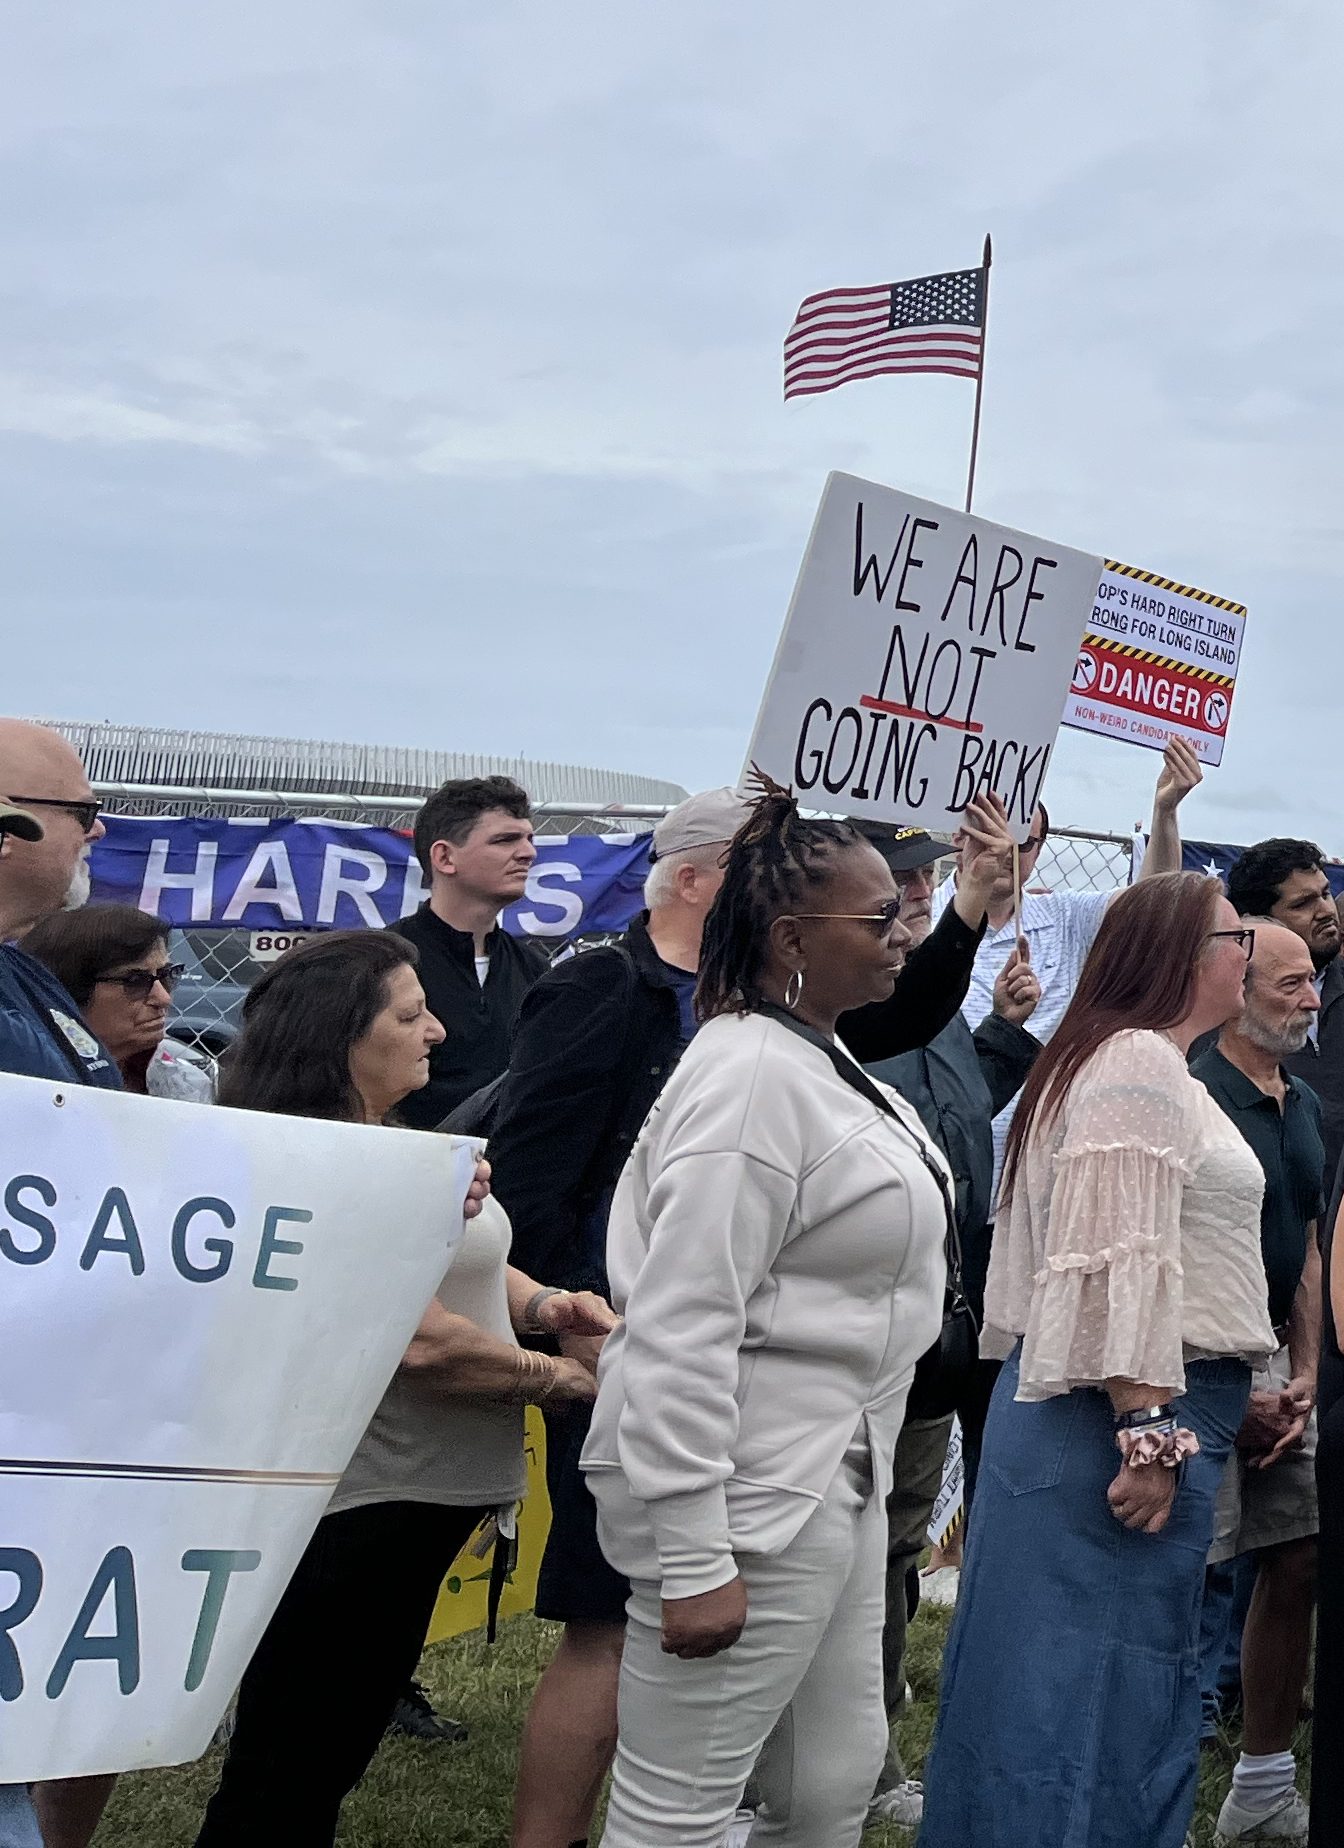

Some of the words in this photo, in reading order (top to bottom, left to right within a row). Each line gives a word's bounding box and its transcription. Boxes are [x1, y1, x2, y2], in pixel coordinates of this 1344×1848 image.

[854, 501, 940, 613] WE
[940, 533, 1058, 652] ARE
[1095, 582, 1128, 607] OP'S
[1130, 592, 1166, 618] HARD
[1166, 605, 1203, 631] RIGHT
[1206, 618, 1237, 642] TURN
[877, 624, 997, 731] NOT
[1091, 605, 1128, 631] RONG
[1130, 618, 1158, 640] FOR
[1158, 626, 1192, 652] LONG
[1193, 638, 1236, 666] ISLAND
[1098, 660, 1202, 720] DANGER
[795, 697, 938, 809] GOING
